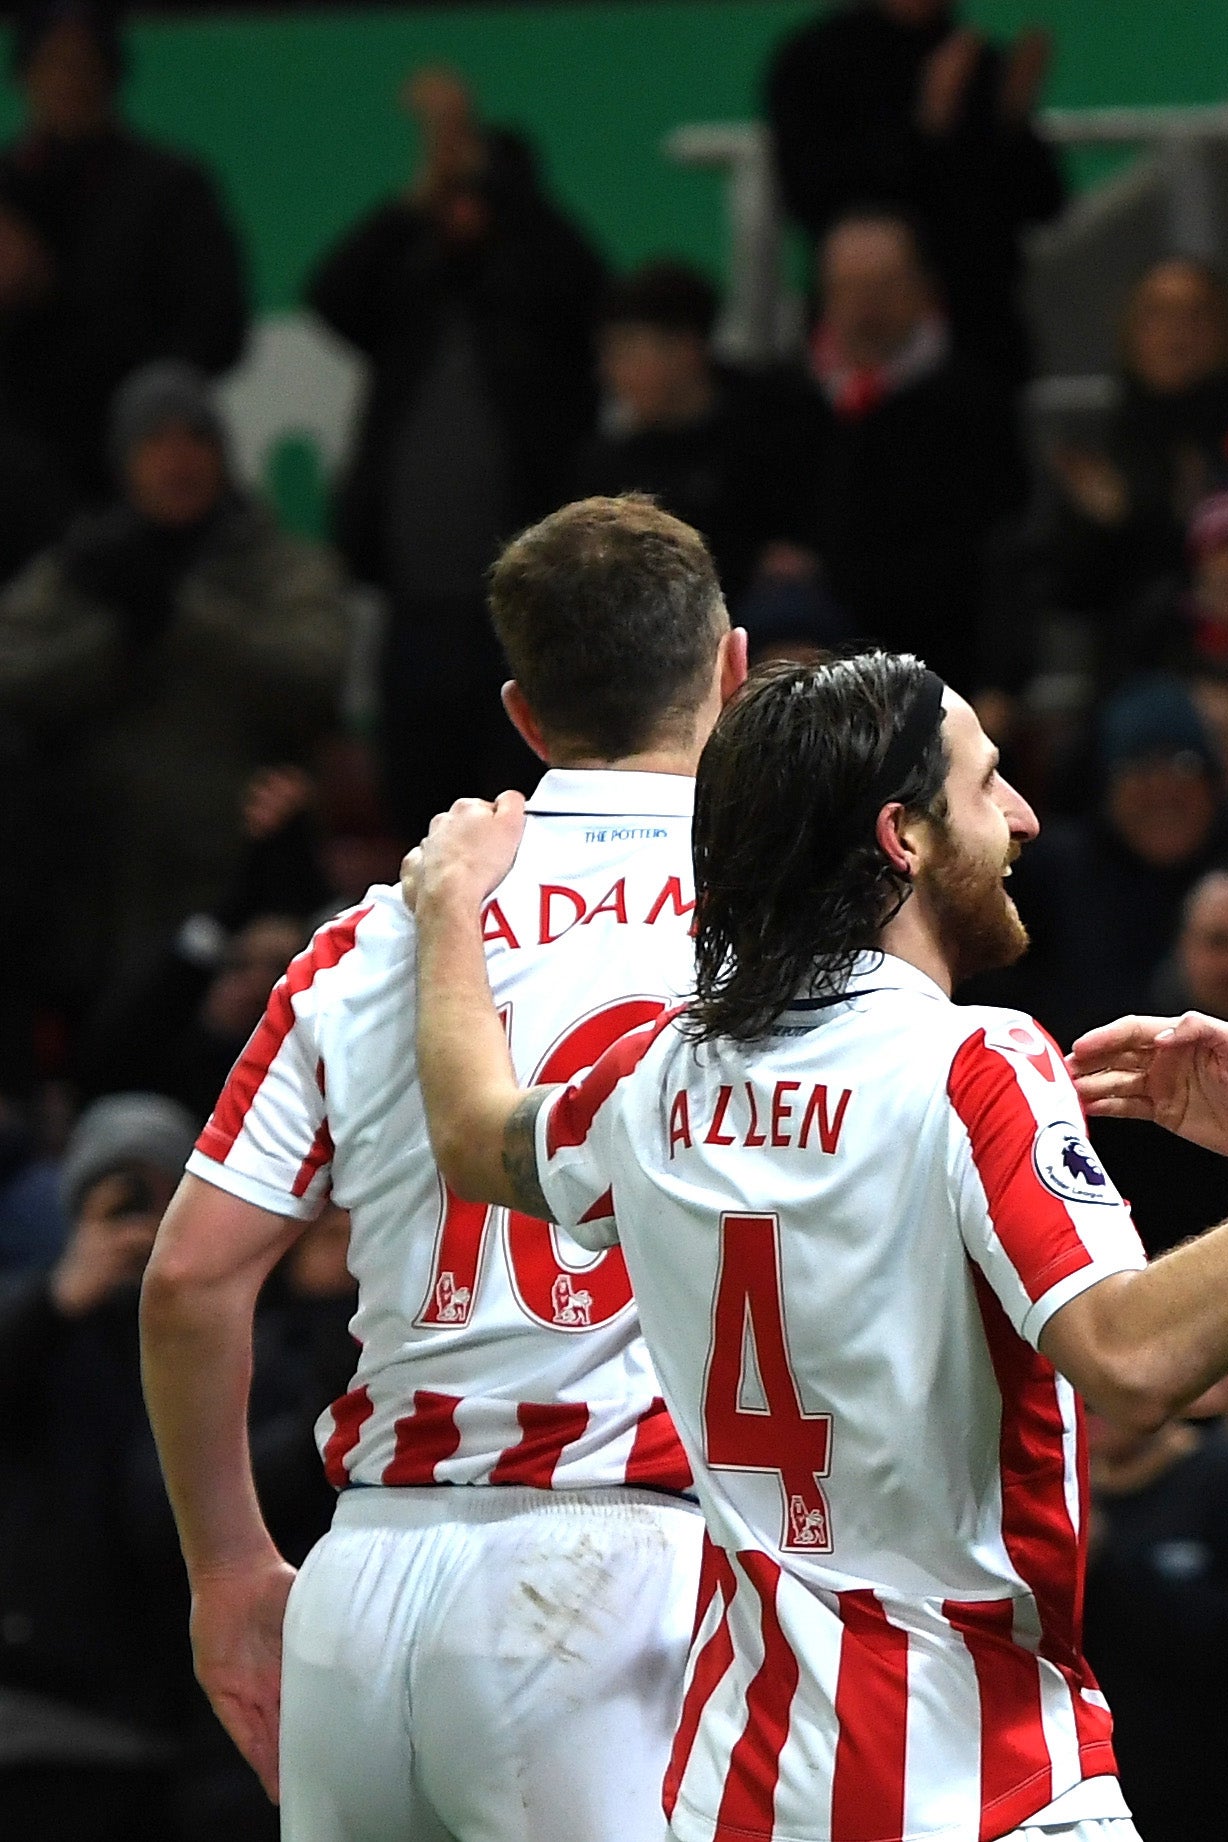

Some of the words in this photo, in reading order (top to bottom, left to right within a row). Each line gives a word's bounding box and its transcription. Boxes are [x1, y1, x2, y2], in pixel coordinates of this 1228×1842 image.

[585, 830, 606, 843] THE
[611, 828, 668, 842] POTTERS
[669, 1081, 853, 1160] ALLEN
[701, 1211, 833, 1553] 4
